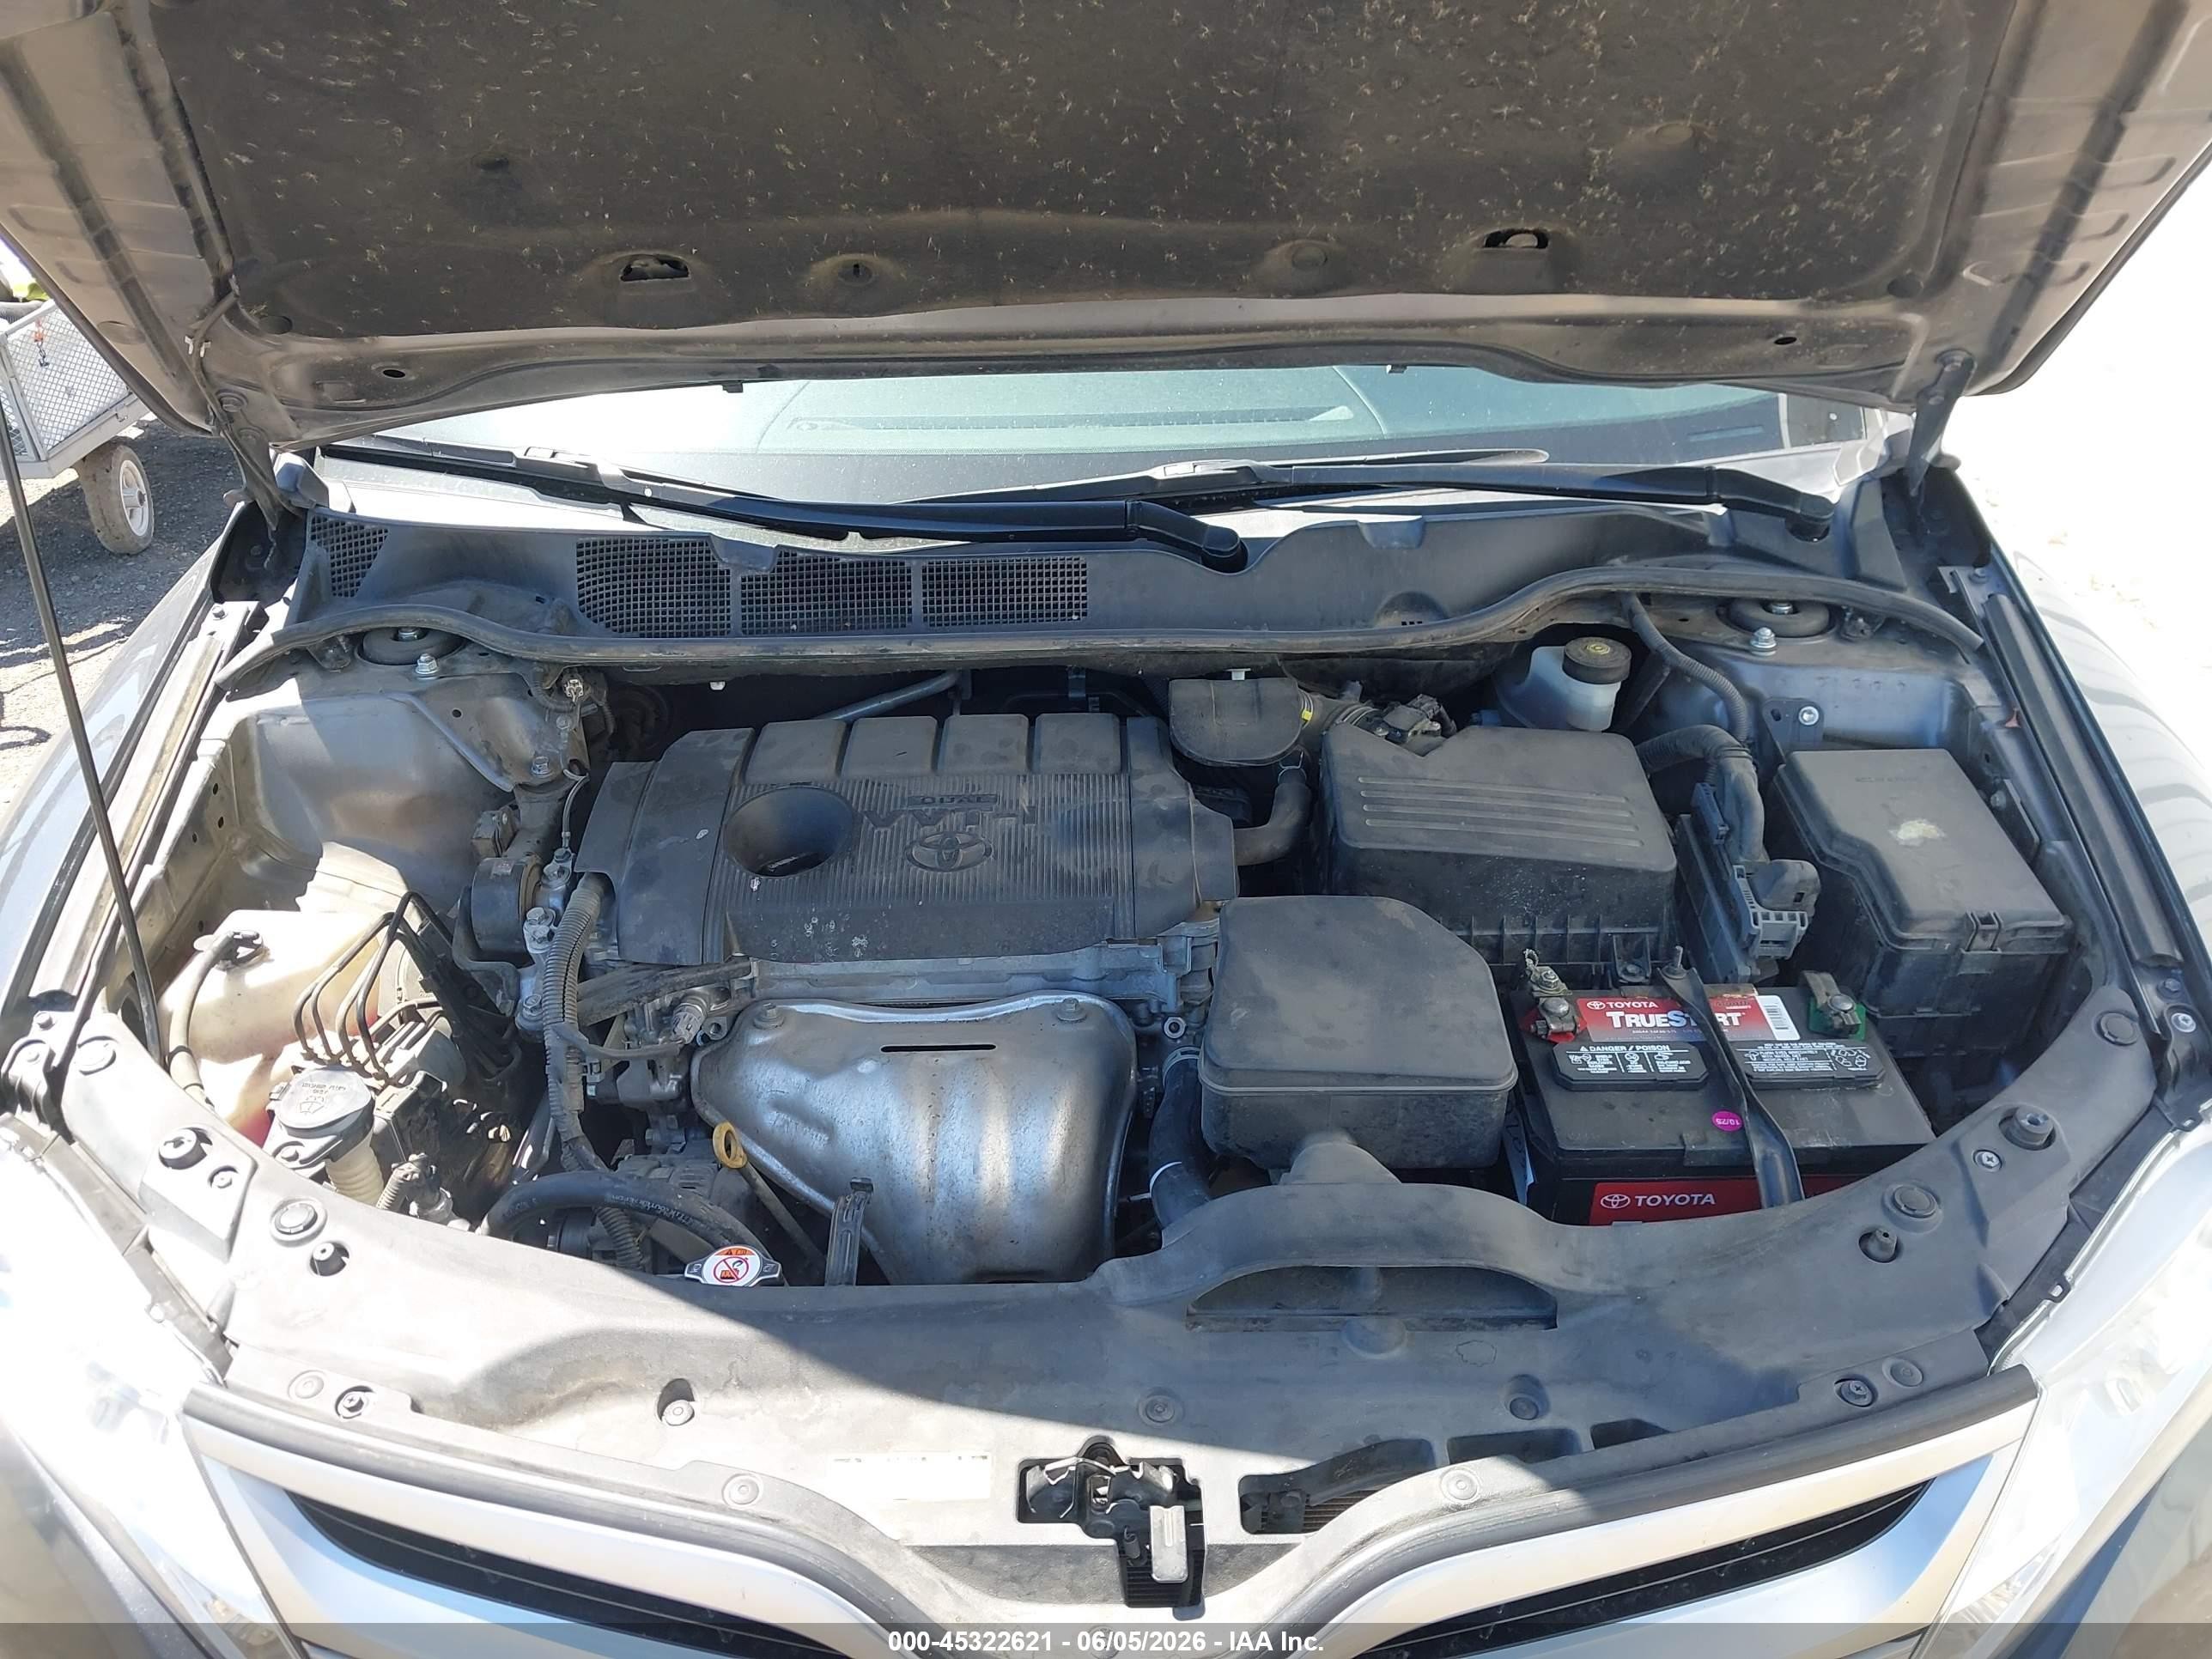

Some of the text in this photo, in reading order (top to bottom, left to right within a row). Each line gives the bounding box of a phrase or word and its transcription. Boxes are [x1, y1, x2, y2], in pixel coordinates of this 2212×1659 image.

[920, 795, 996, 805] DUAL
[1606, 1010, 1741, 1029] TRUESRT
[1634, 1194, 1716, 1206] TOYOTA
